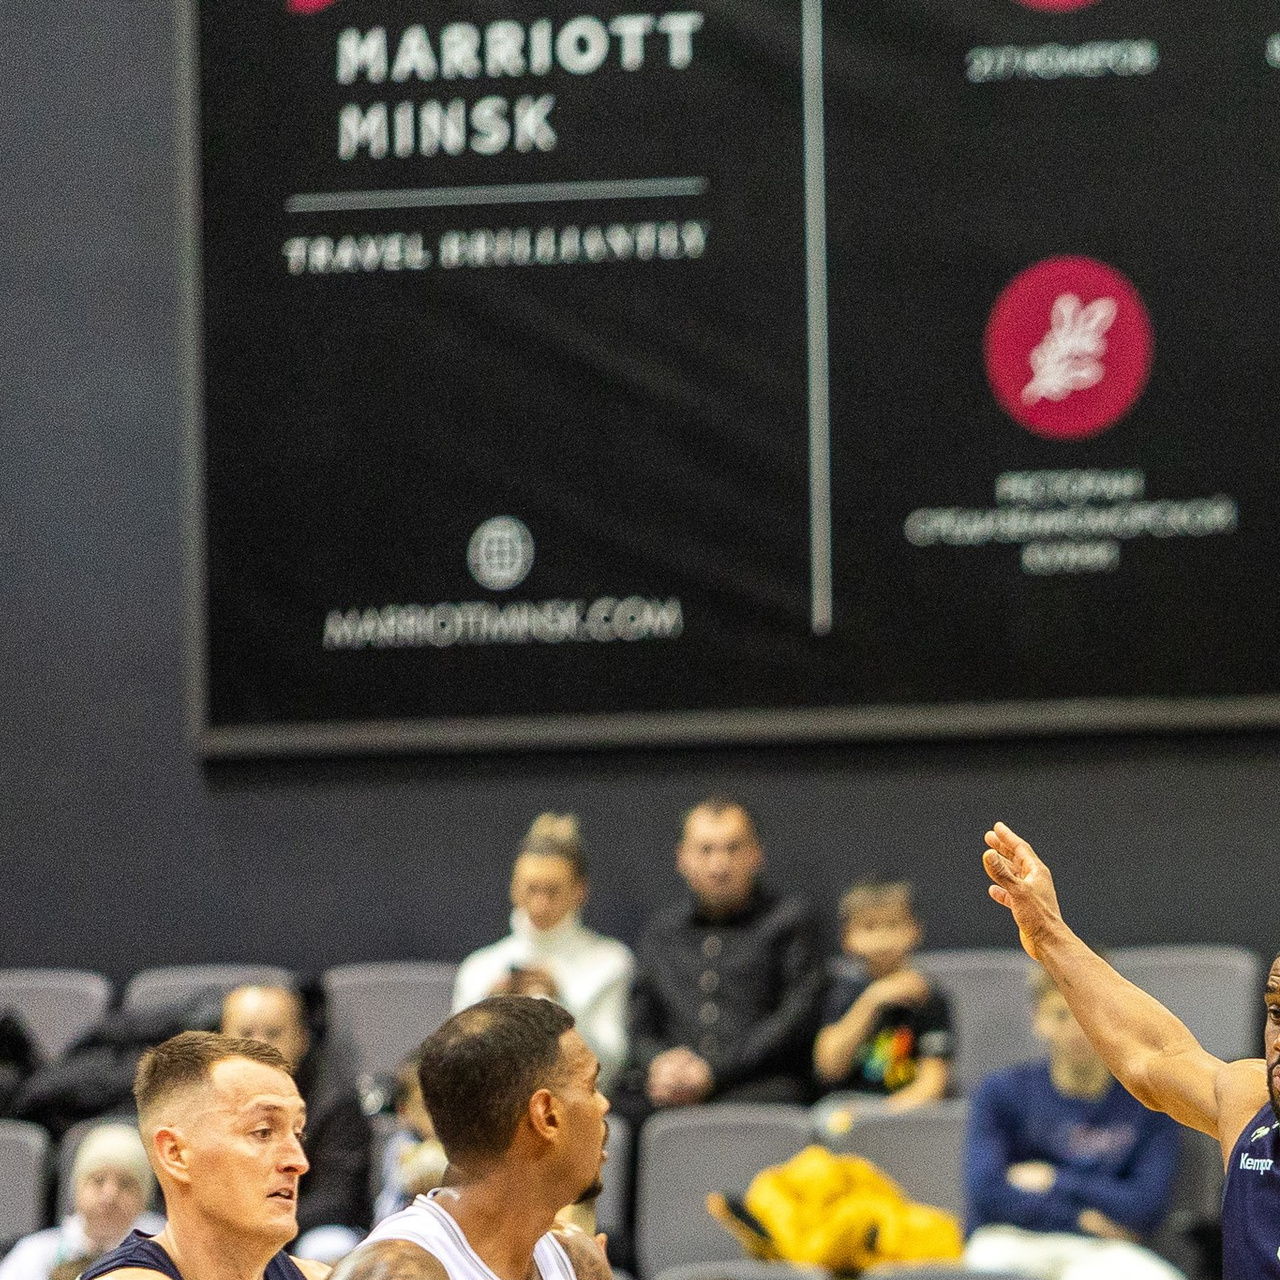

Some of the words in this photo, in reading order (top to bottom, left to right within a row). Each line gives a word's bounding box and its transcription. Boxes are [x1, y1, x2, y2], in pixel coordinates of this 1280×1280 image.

[337, 11, 703, 84] MARRIOTT
[338, 95, 557, 160] MINSK
[284, 233, 431, 273] TRAVEL
[323, 597, 683, 649] MARRIOTTMINSK.COM
